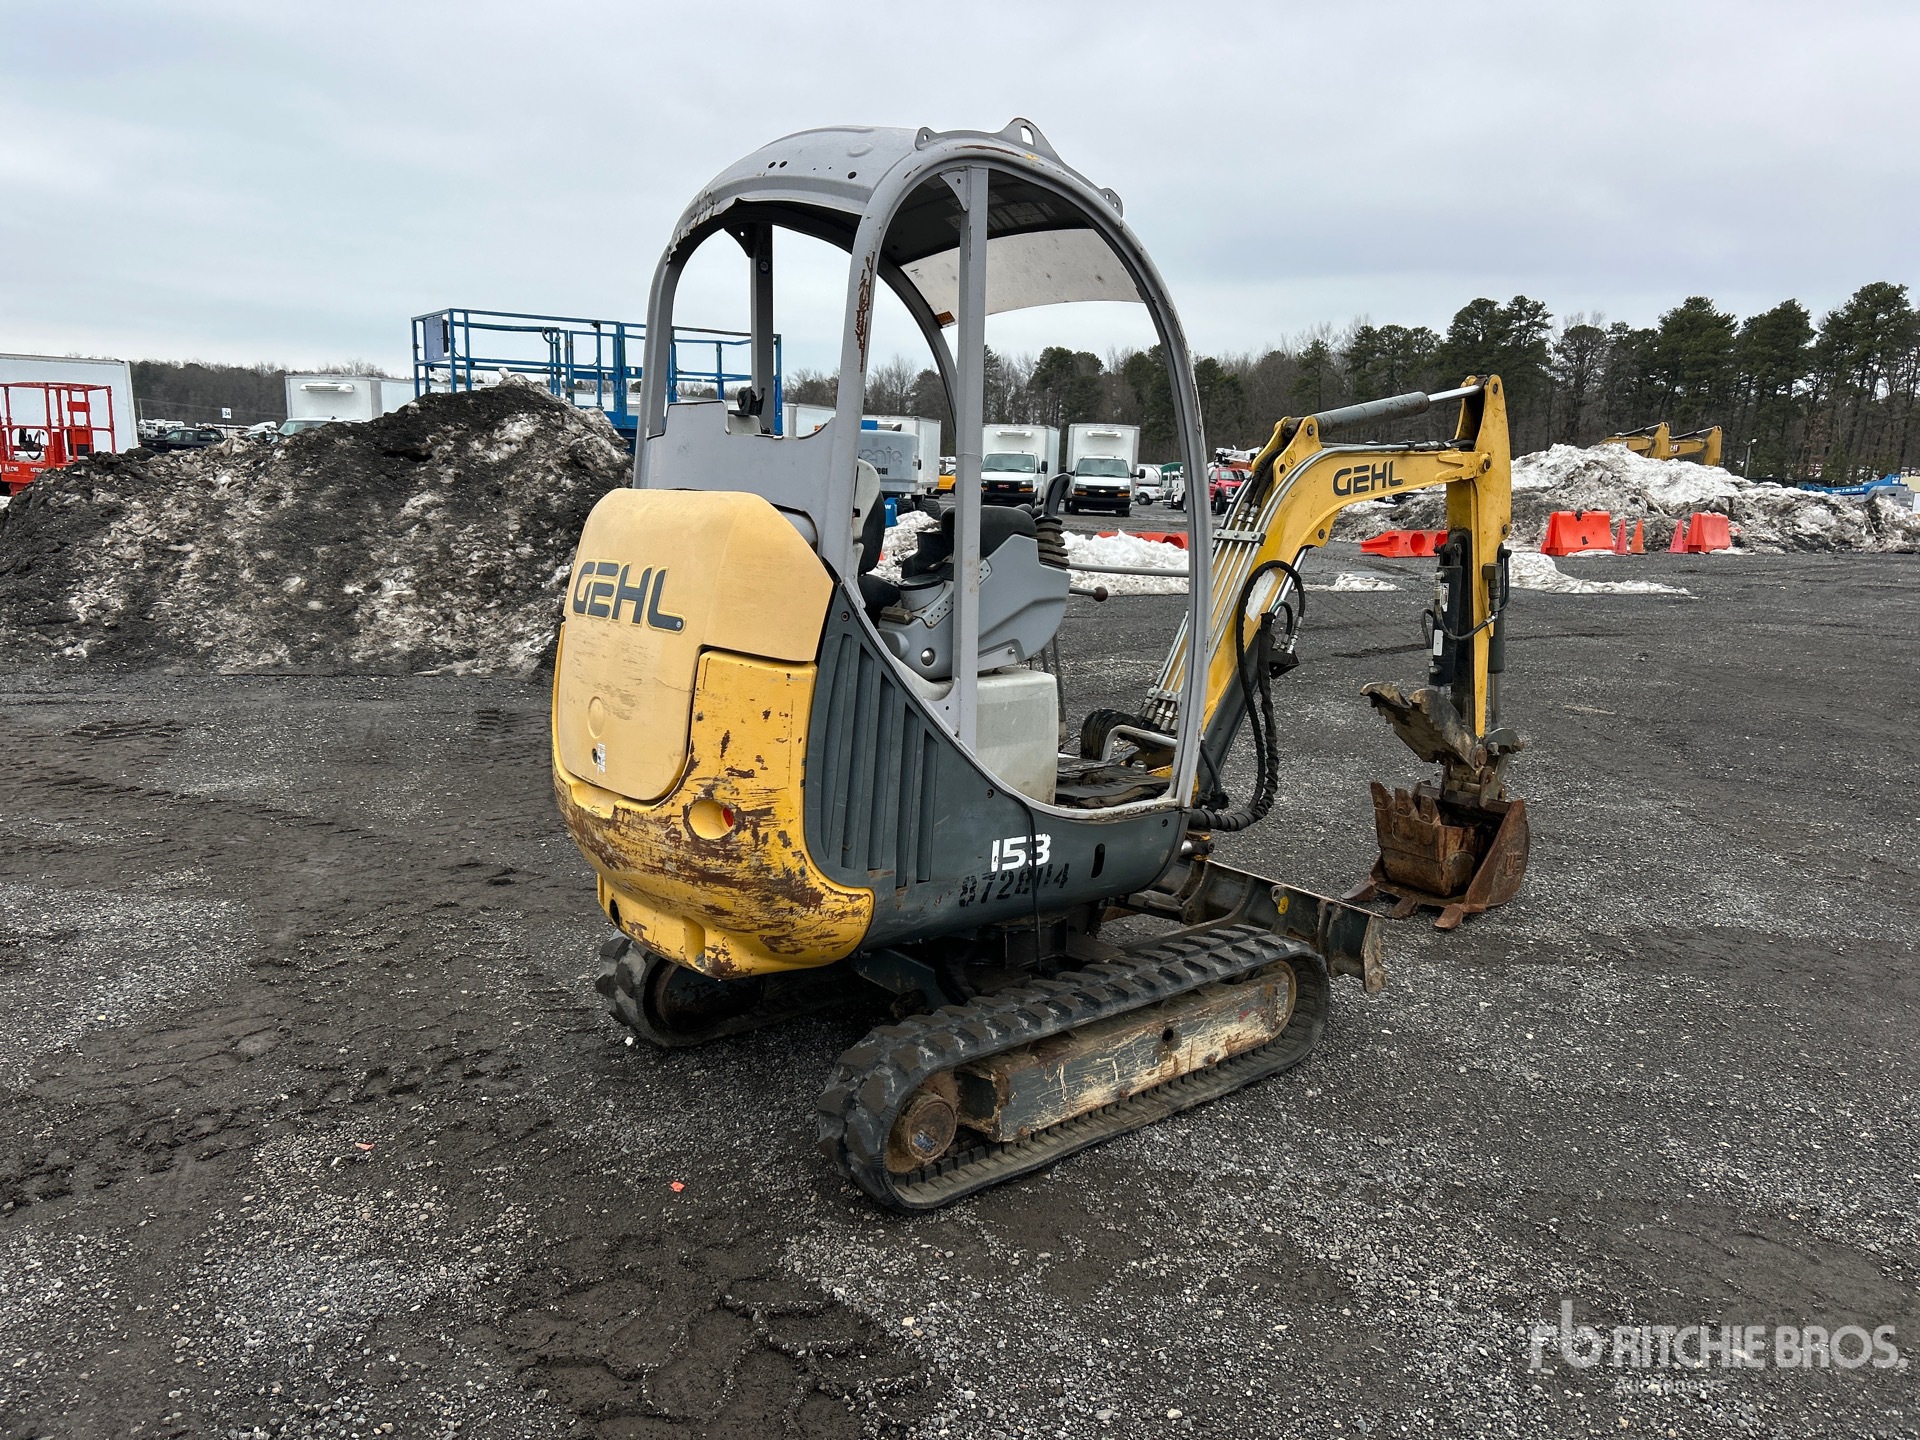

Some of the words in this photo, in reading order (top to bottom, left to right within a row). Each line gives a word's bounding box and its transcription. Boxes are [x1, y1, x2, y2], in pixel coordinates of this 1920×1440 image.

[1332, 459, 1404, 496] GEHL
[572, 558, 686, 634] GEHL
[990, 832, 1052, 873] 153
